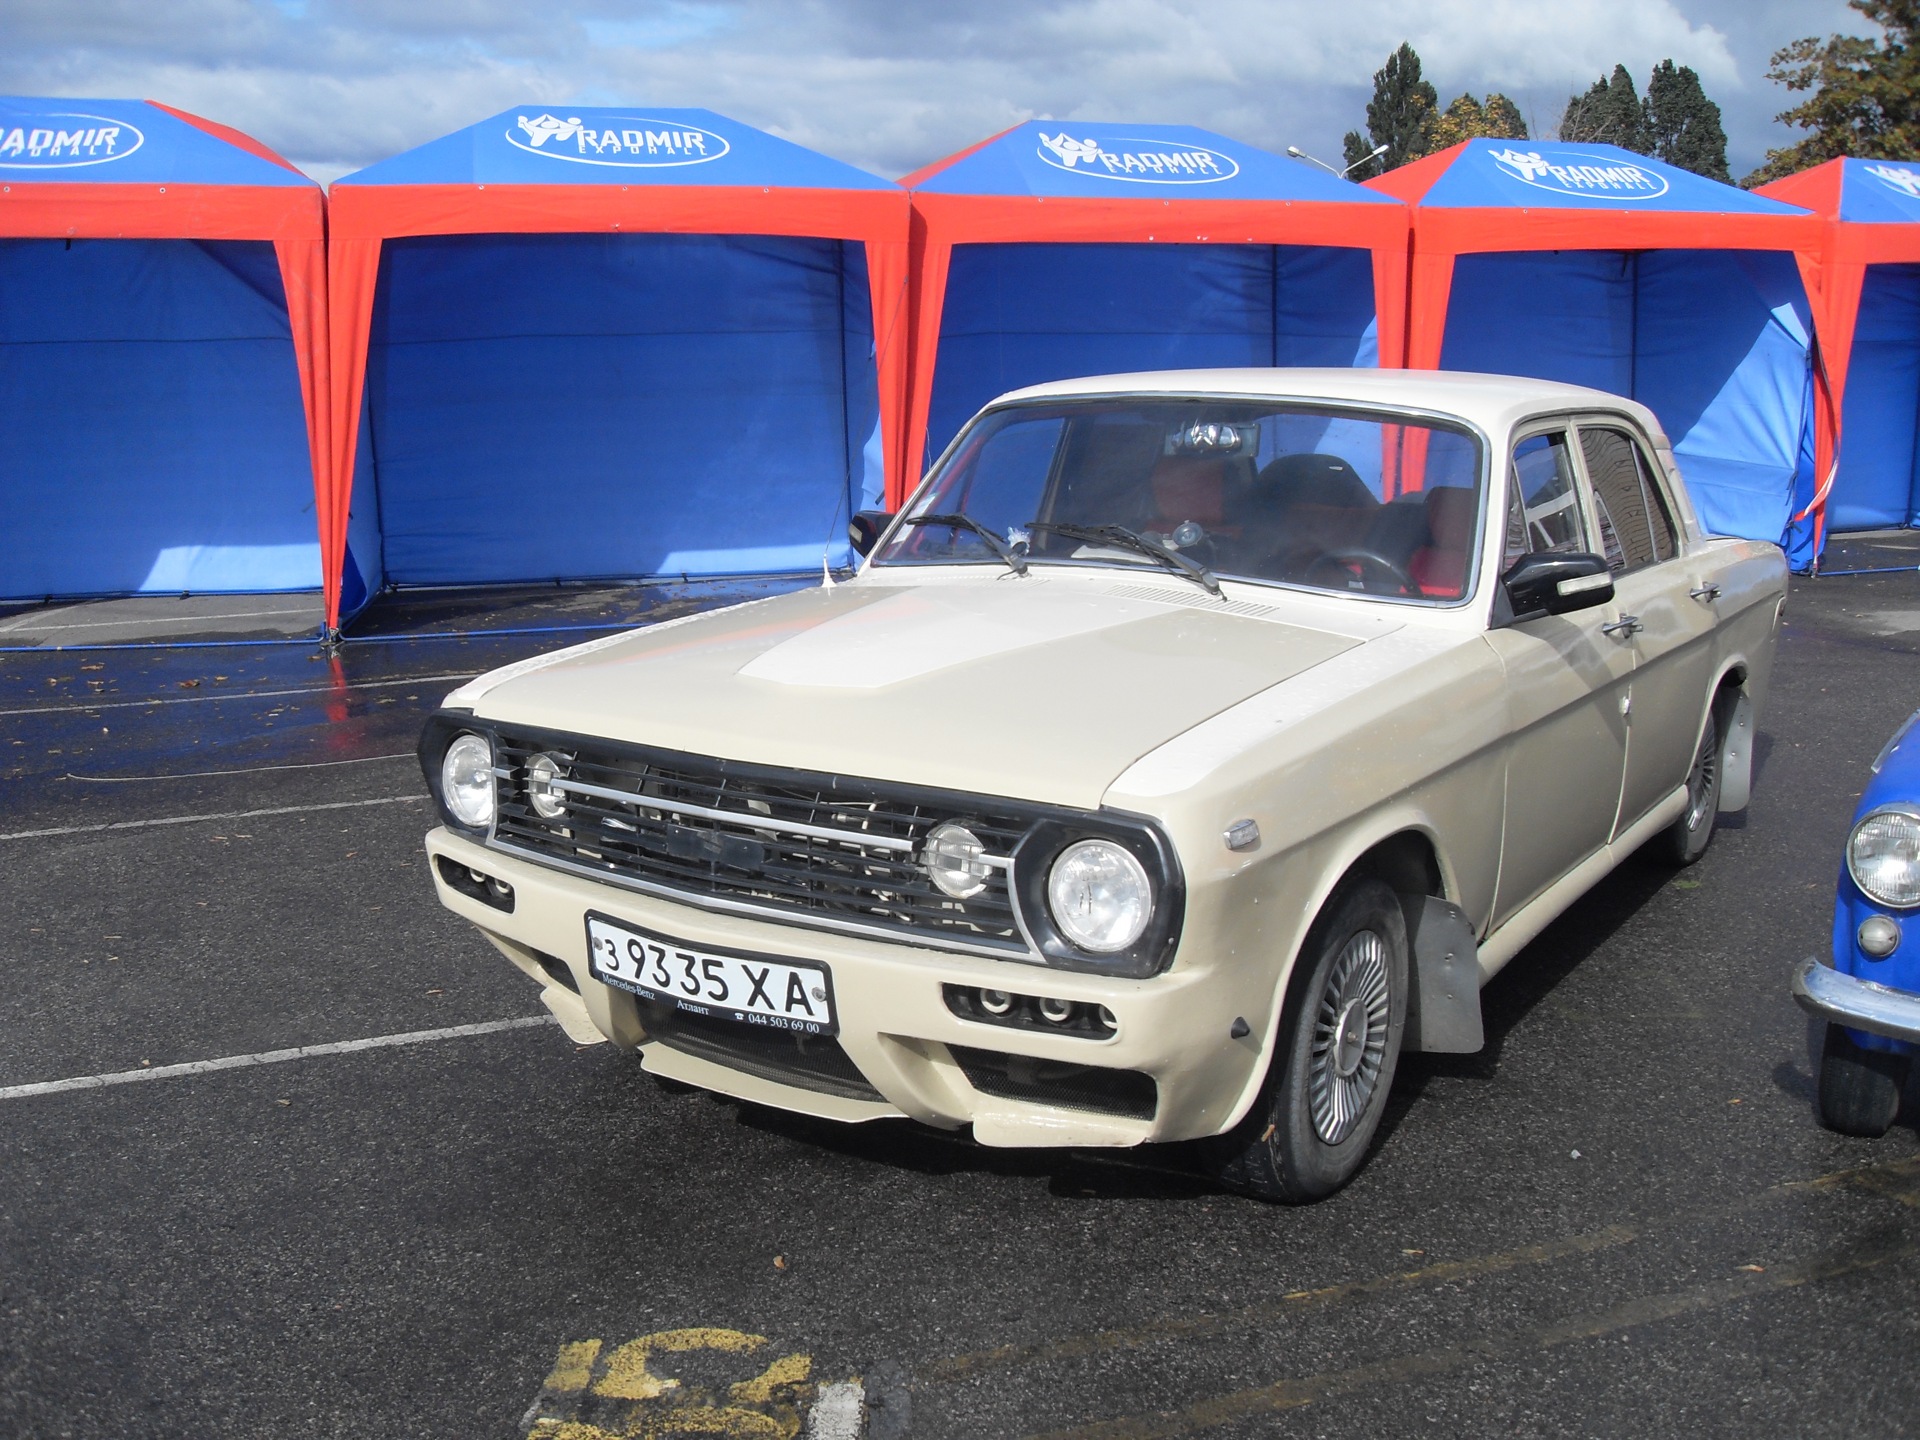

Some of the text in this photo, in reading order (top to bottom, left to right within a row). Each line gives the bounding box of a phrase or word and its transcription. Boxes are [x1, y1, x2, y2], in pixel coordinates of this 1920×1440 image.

[0, 127, 120, 151] ADMIR
[577, 128, 706, 149] RADMIR
[1099, 151, 1218, 169] RADMIR
[1547, 165, 1650, 184] RADMIR
[602, 973, 655, 1000] Mercedes-Benz
[677, 1000, 709, 1015] Атлант
[748, 1013, 819, 1033] 044 503 69 00
